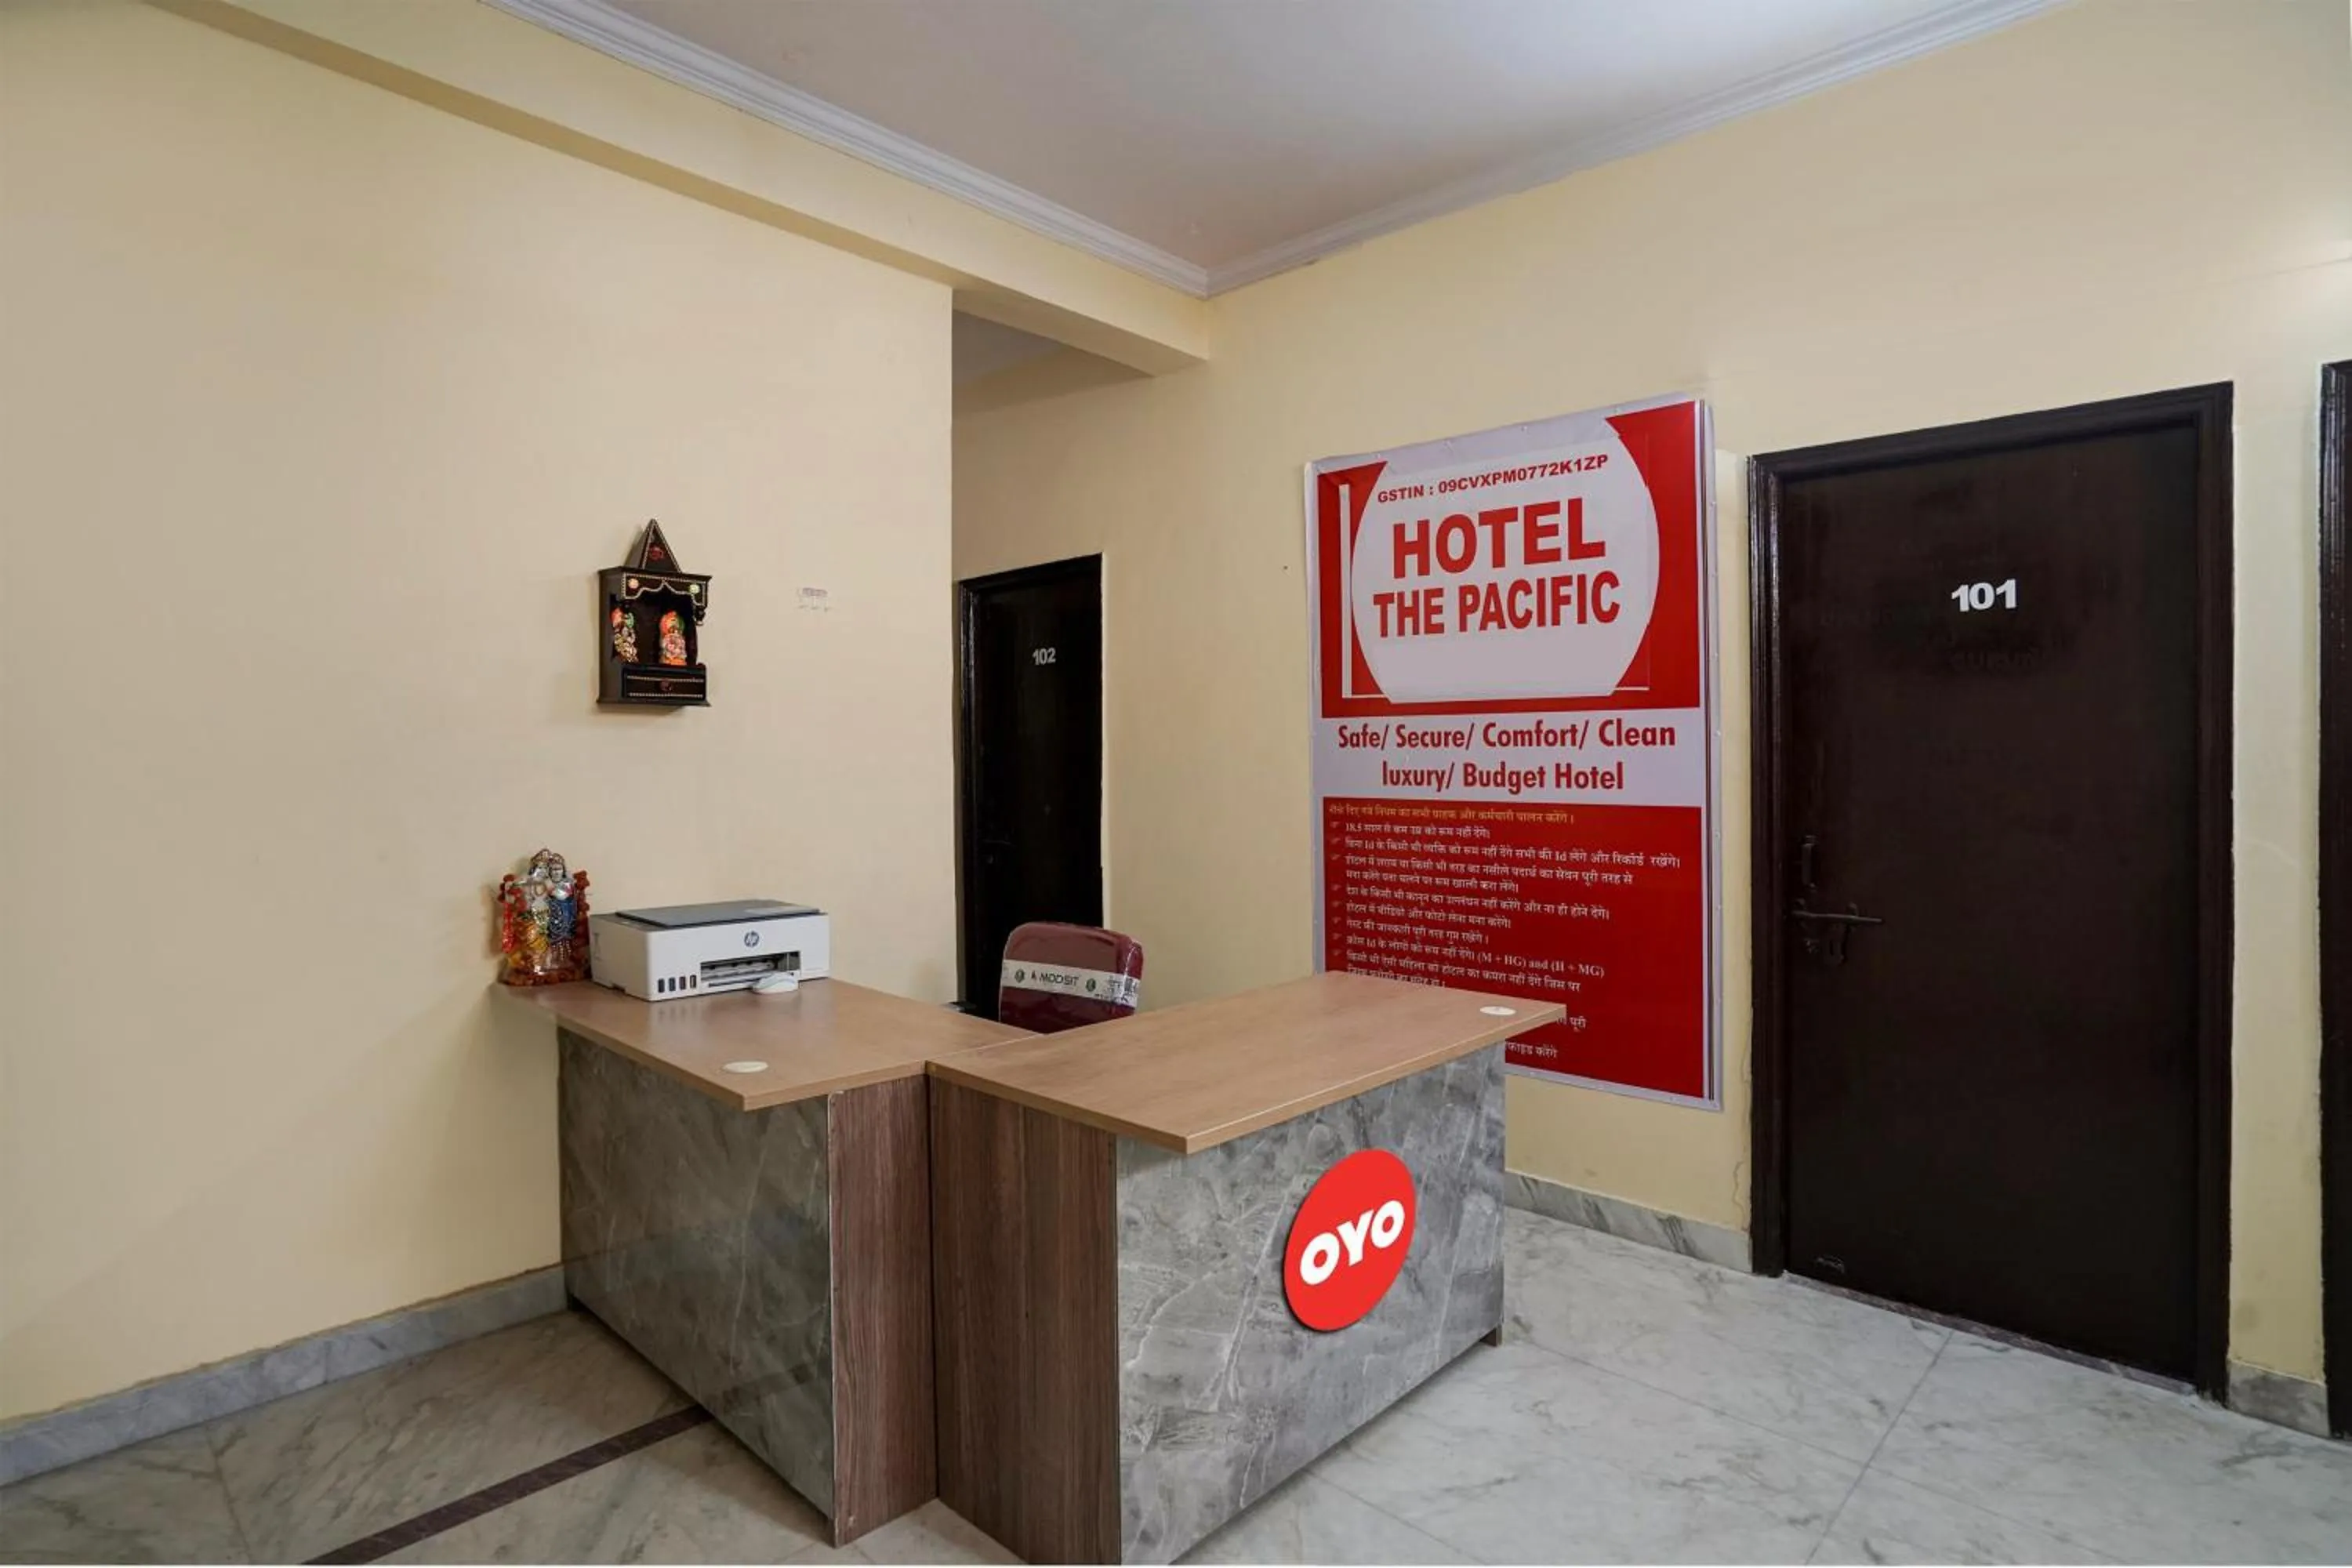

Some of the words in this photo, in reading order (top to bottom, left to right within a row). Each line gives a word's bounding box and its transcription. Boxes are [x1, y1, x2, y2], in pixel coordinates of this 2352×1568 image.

[1377, 485, 1425, 503] GSTIN
[1438, 454, 1610, 495] 09CVXPM0772K1ZP
[1393, 497, 1606, 579] HOTEL
[1373, 587, 1445, 638] THE
[1457, 570, 1621, 633] PACIFIC
[1951, 579, 2016, 612] 101
[1032, 647, 1056, 666] 102
[1338, 724, 1389, 751] Safe/
[1396, 722, 1475, 751] Secure/
[1482, 719, 1590, 750] Comfort/
[1599, 718, 1676, 747] Clean
[1382, 760, 1455, 793] luxury/
[1463, 762, 1546, 795] Budget
[1555, 761, 1624, 791] Hotel
[1591, 849, 1610, 864] और
[1556, 866, 1578, 881] सेवन
[1582, 869, 1598, 887] पूरी
[1602, 873, 1621, 884] तरह
[1623, 870, 1633, 884] से
[1524, 899, 1541, 913] और
[1528, 959, 1548, 971] and
[1299, 1200, 1406, 1286] OYO
